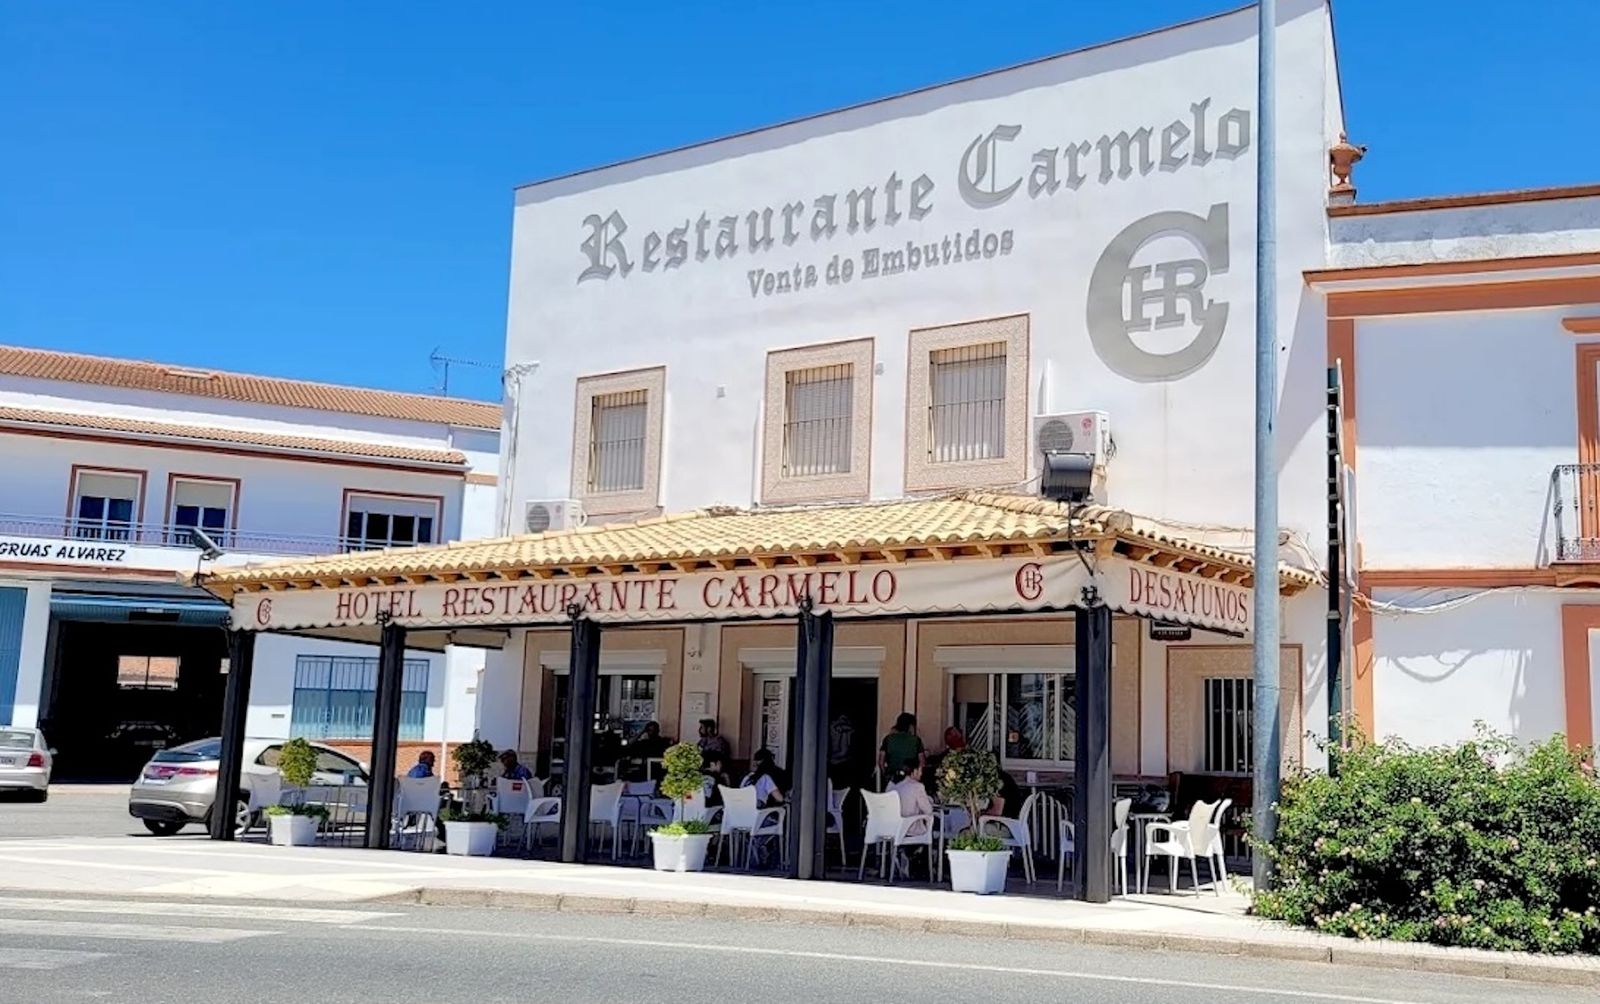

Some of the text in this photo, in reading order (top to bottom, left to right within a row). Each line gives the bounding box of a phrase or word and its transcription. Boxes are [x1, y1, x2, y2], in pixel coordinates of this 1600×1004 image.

[577, 97, 1251, 284] Restaurante Carmelo
[747, 227, 1014, 298] Venta de Embutidos
[0, 543, 126, 561] GRUAS ALVAREZ
[336, 569, 897, 620] HOTEL RESTAURANTE CARMELO
[1128, 567, 1248, 625] DESAYUNOS
